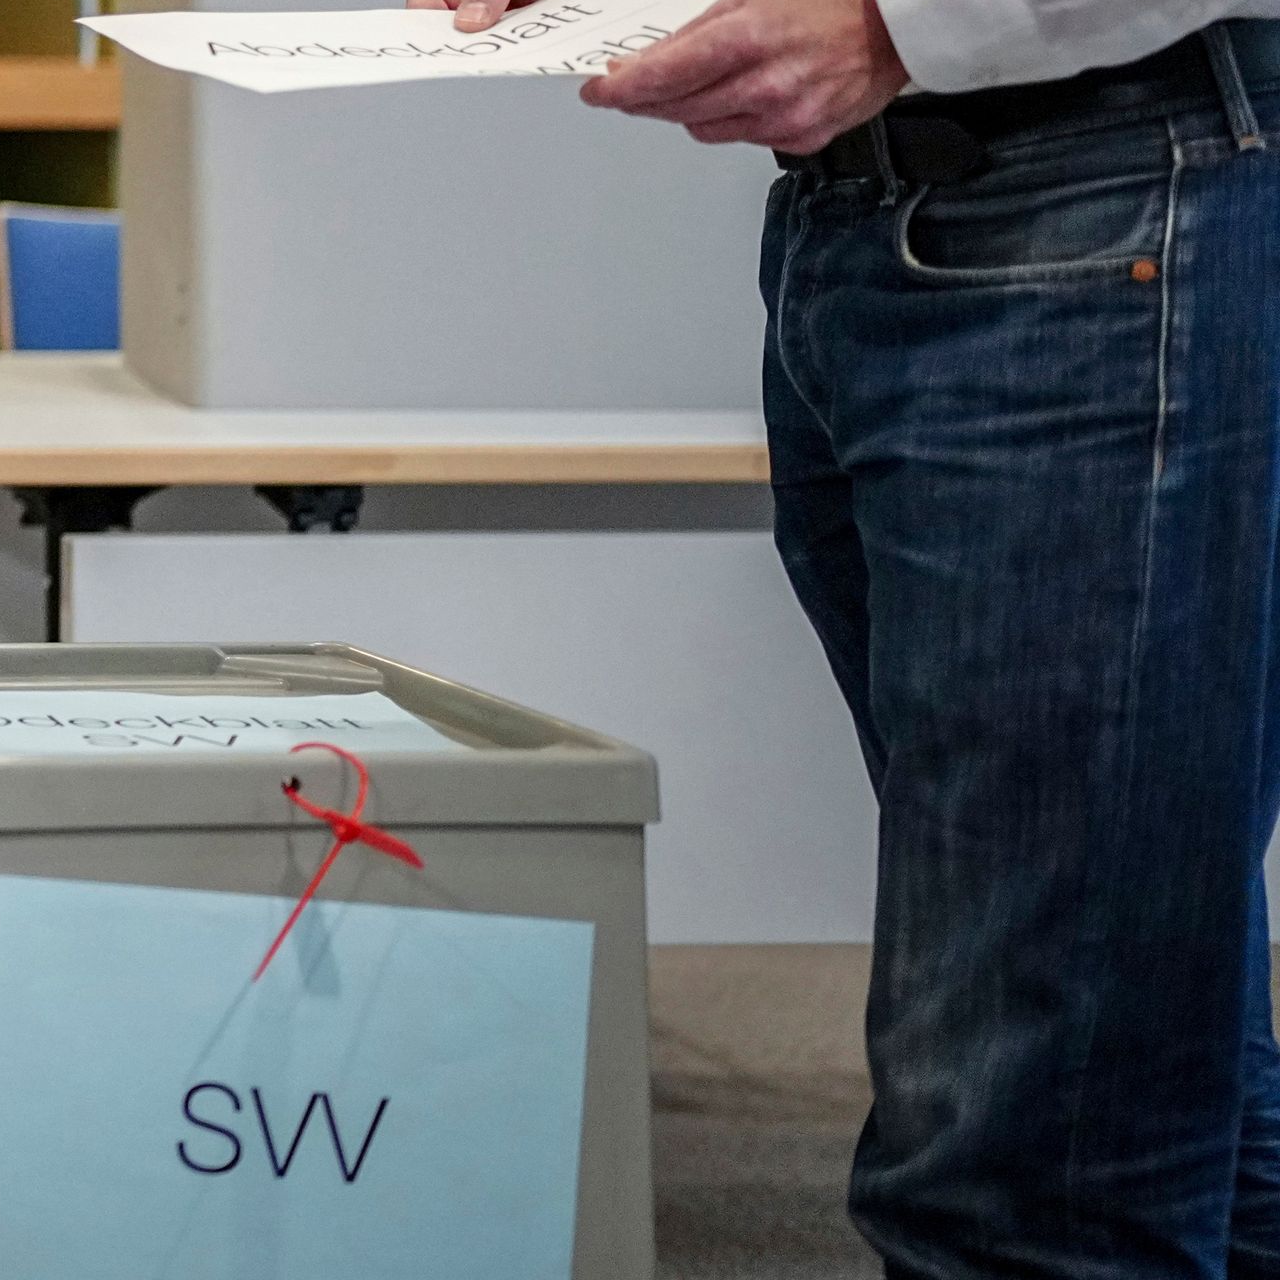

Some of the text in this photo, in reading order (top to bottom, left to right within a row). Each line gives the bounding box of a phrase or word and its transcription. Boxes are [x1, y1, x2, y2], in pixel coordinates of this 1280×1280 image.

[206, 2, 603, 58] Abdeckblatt
[83, 733, 238, 748] SW
[176, 1080, 391, 1185] SW
